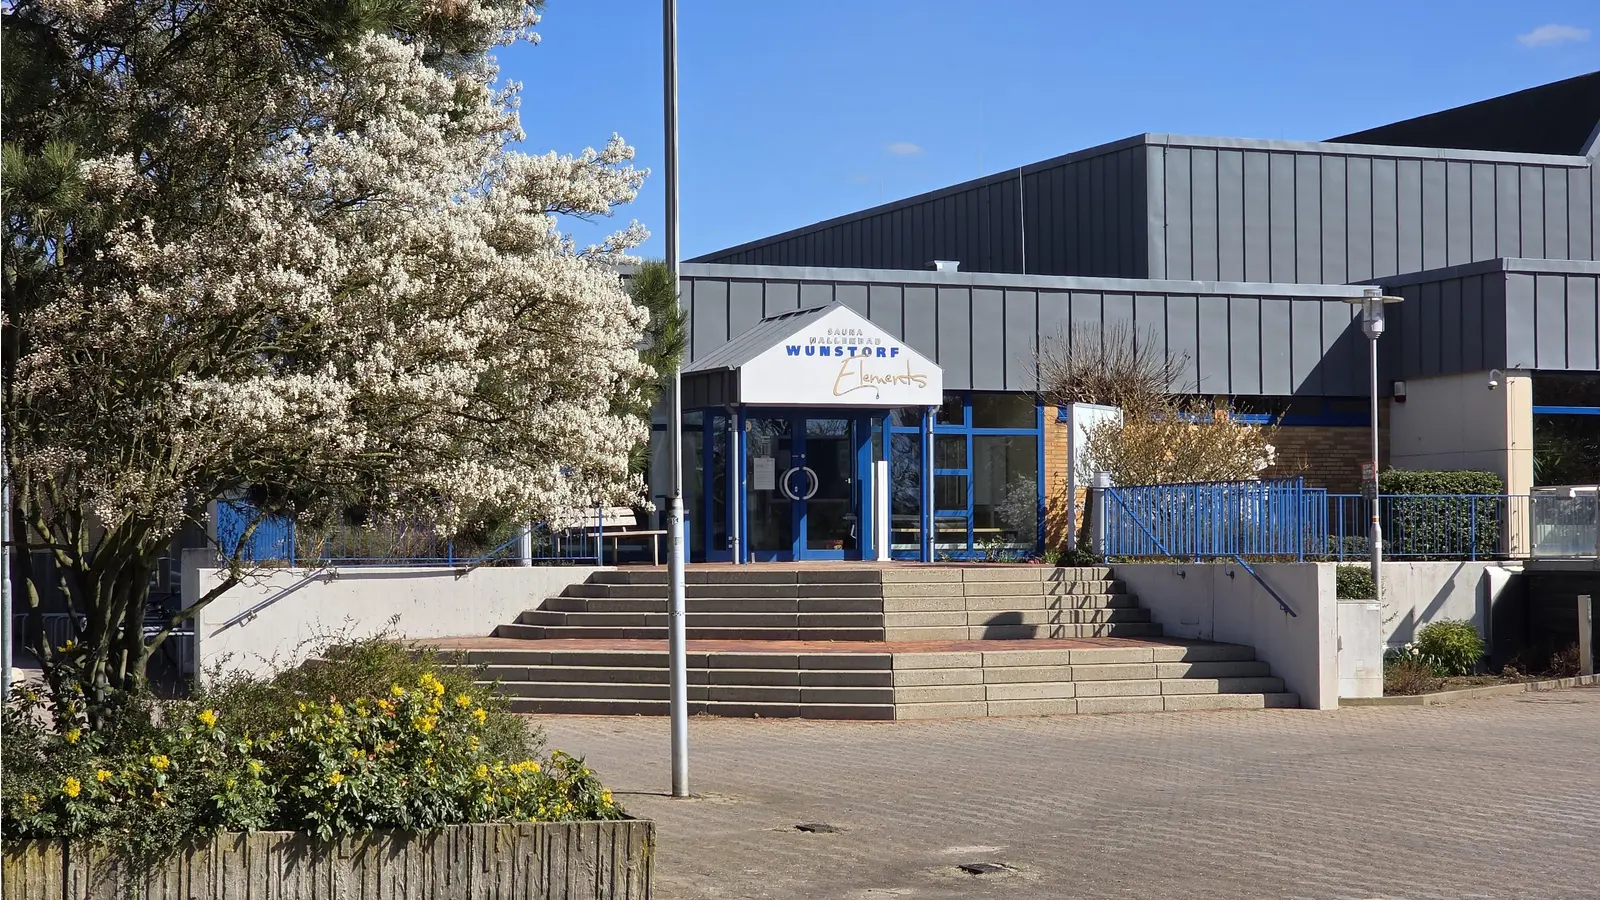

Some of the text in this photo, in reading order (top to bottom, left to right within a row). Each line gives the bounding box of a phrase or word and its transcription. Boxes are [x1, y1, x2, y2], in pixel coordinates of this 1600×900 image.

[827, 328, 863, 336] SAUNA
[785, 345, 900, 358] WUNSTORF
[833, 354, 928, 396] Elements
